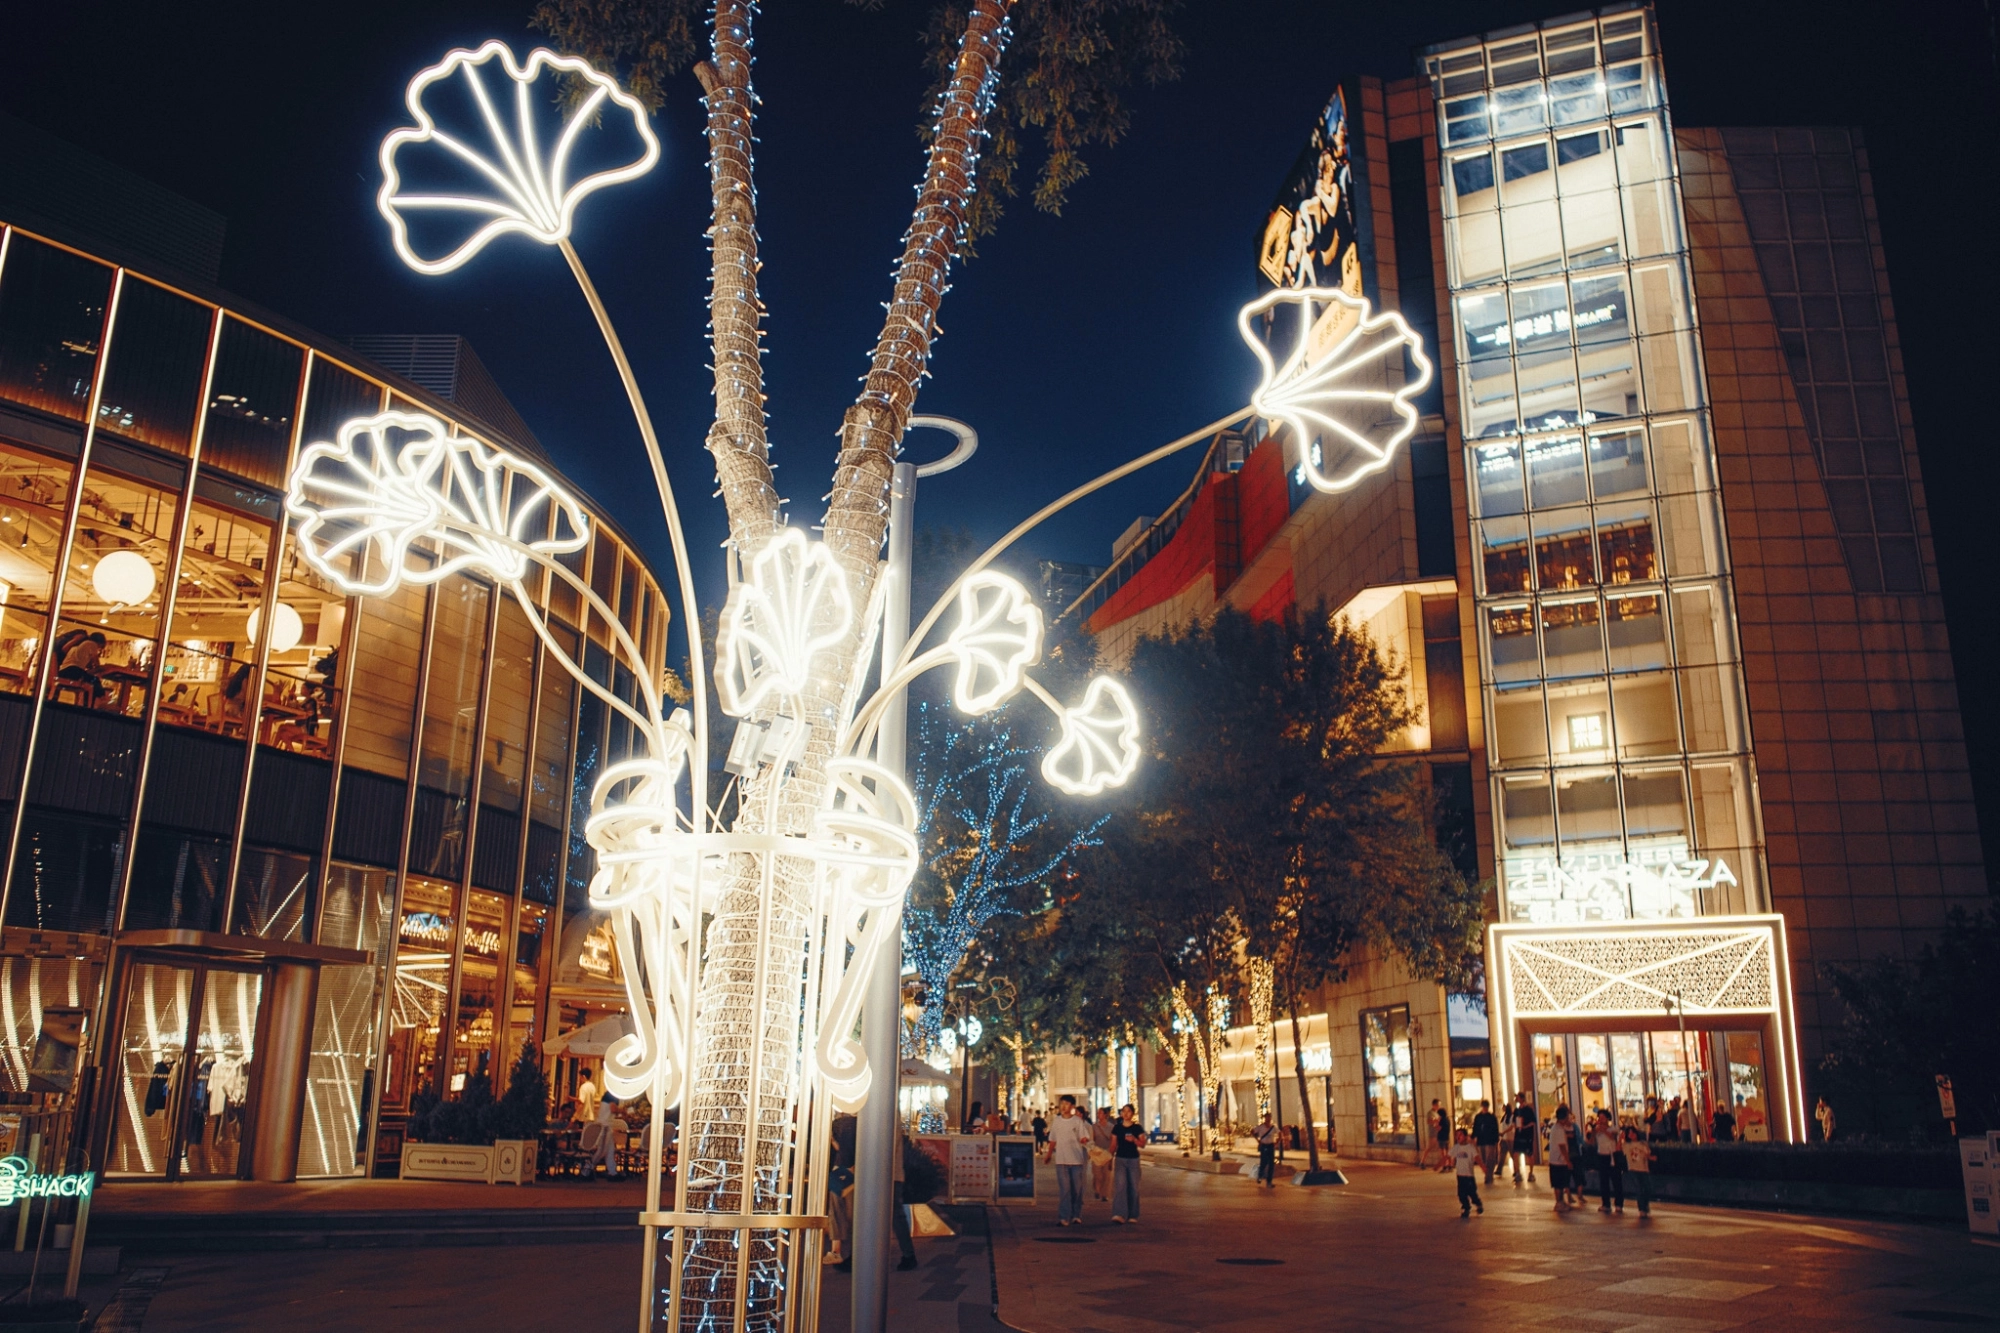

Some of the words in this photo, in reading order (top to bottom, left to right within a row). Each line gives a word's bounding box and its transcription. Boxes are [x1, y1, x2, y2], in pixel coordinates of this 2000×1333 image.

[1520, 856, 1576, 873] 247
[1617, 857, 1738, 890] PAZA
[17, 1177, 91, 1198] SHACK
